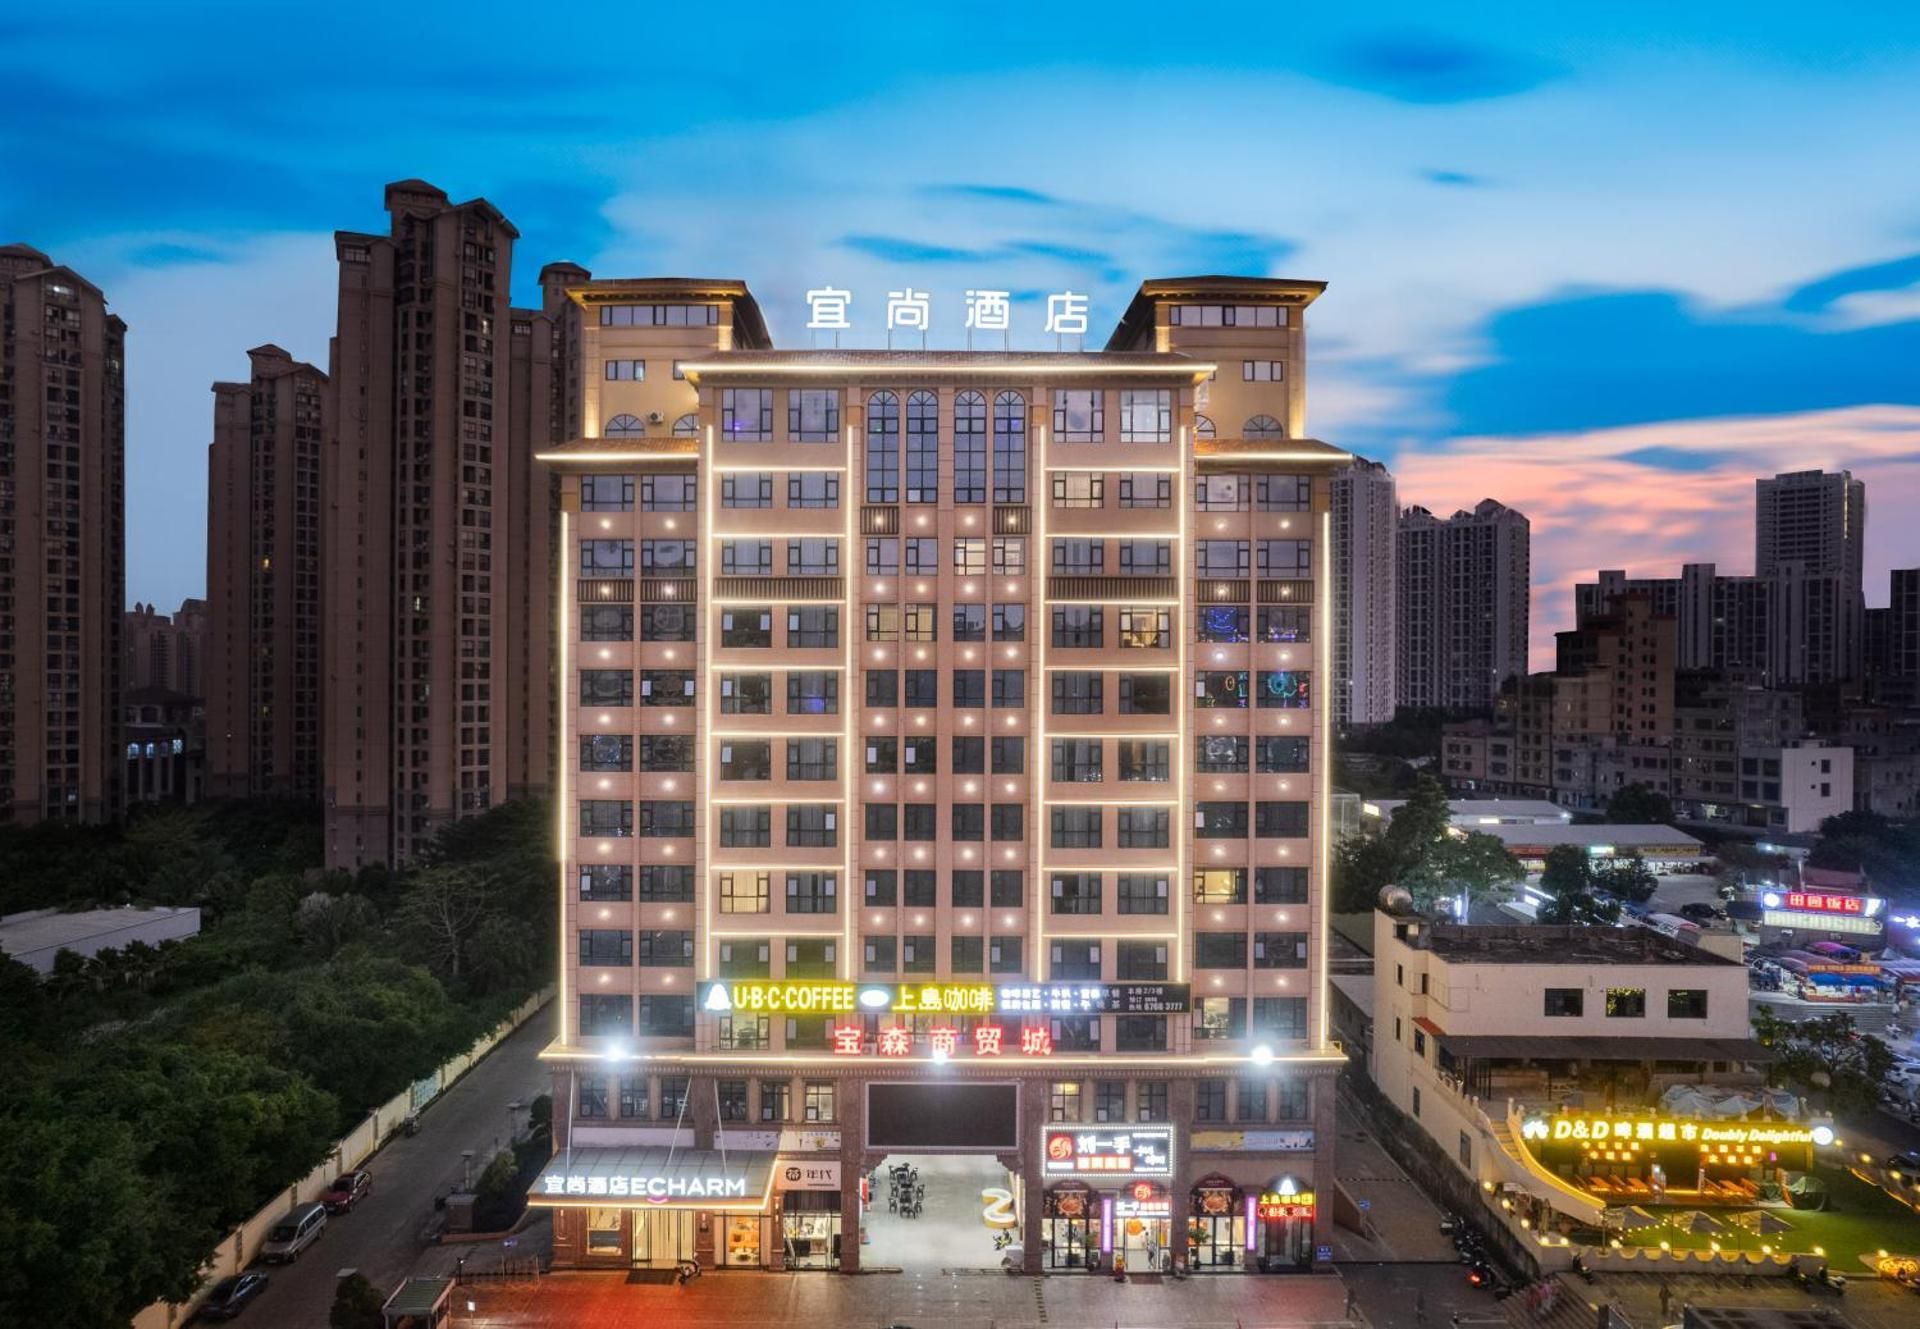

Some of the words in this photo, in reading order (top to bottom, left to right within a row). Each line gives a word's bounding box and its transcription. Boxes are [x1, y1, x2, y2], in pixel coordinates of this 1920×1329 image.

[806, 286, 1089, 334] 宜尚酒店
[834, 1026, 1053, 1056] 宝森商贸城
[1554, 1120, 1609, 1139] D&D
[544, 1176, 628, 1194] 宜尚酒店
[630, 1178, 746, 1195] ECHARM
